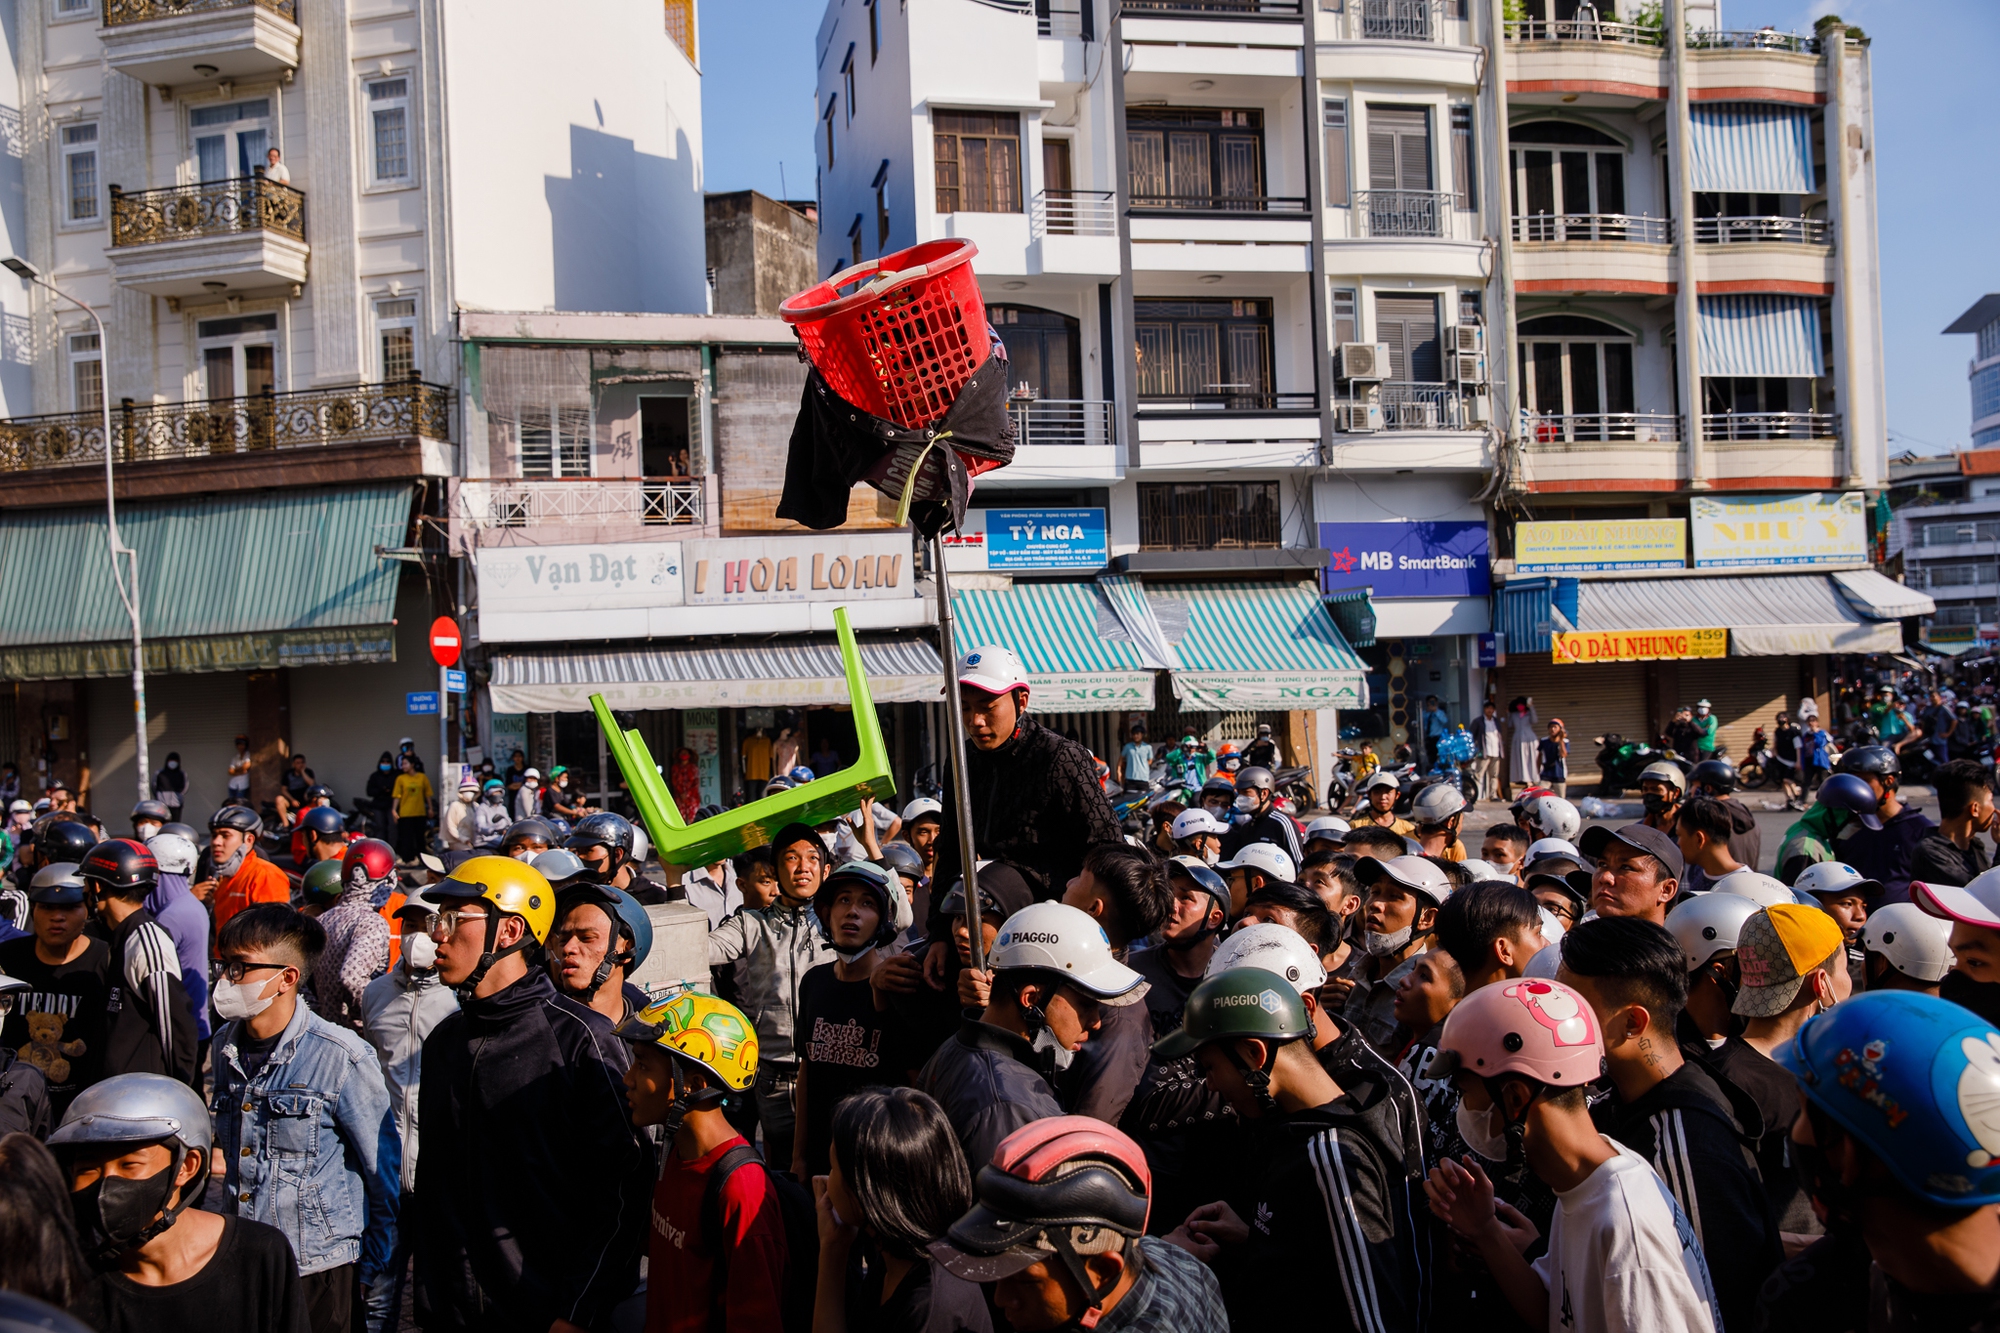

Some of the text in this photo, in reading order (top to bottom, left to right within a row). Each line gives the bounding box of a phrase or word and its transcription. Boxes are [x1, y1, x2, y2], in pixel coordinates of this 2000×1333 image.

[1762, 499, 1804, 514] HÀNG
[1009, 520, 1085, 540] TỶ NGA
[1523, 523, 1677, 544] ÁO DÀI NHUNG
[1712, 516, 1808, 543] NHƯ
[1361, 551, 1477, 571] MB SmartBank
[525, 553, 637, 591] Vạn Đạt
[725, 557, 798, 594] HOA
[811, 553, 902, 590] LOAN
[1588, 633, 1620, 657] DÀI
[1626, 635, 1687, 656] NHUNG
[1692, 630, 1723, 640] 459
[1238, 675, 1266, 683] PHẨM
[1064, 687, 1145, 700] NGA
[1278, 686, 1359, 698] NGA
[1012, 932, 1059, 945] PIAGGIO
[18, 992, 83, 1019] TEDDY
[1213, 994, 1259, 1009] PIAGGIO
